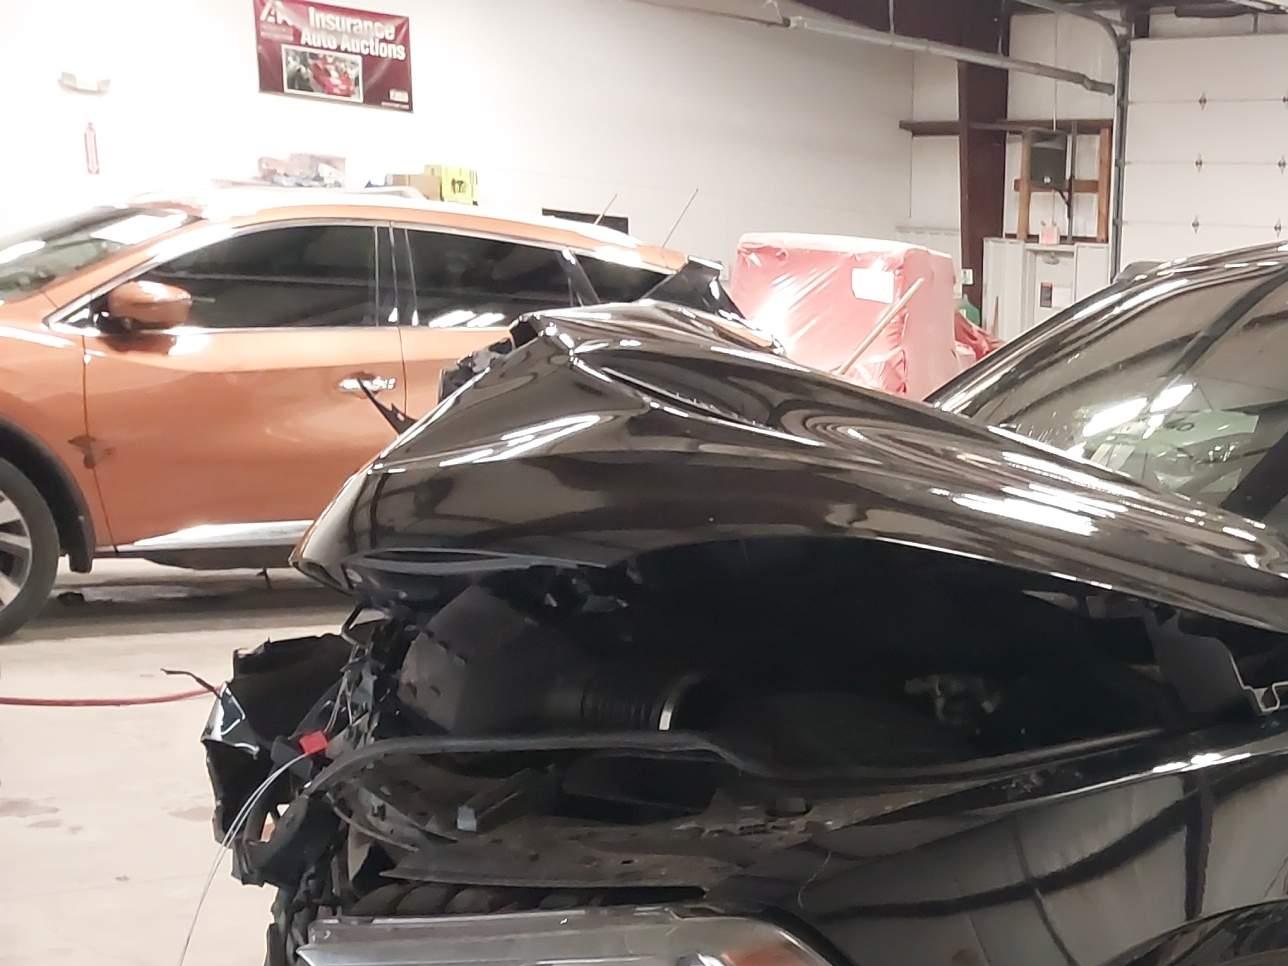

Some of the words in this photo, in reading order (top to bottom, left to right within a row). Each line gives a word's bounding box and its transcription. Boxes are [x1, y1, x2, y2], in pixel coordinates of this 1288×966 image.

[309, 6, 396, 41] Insurance
[300, 29, 338, 50] Auto
[340, 36, 407, 61] Auctions
